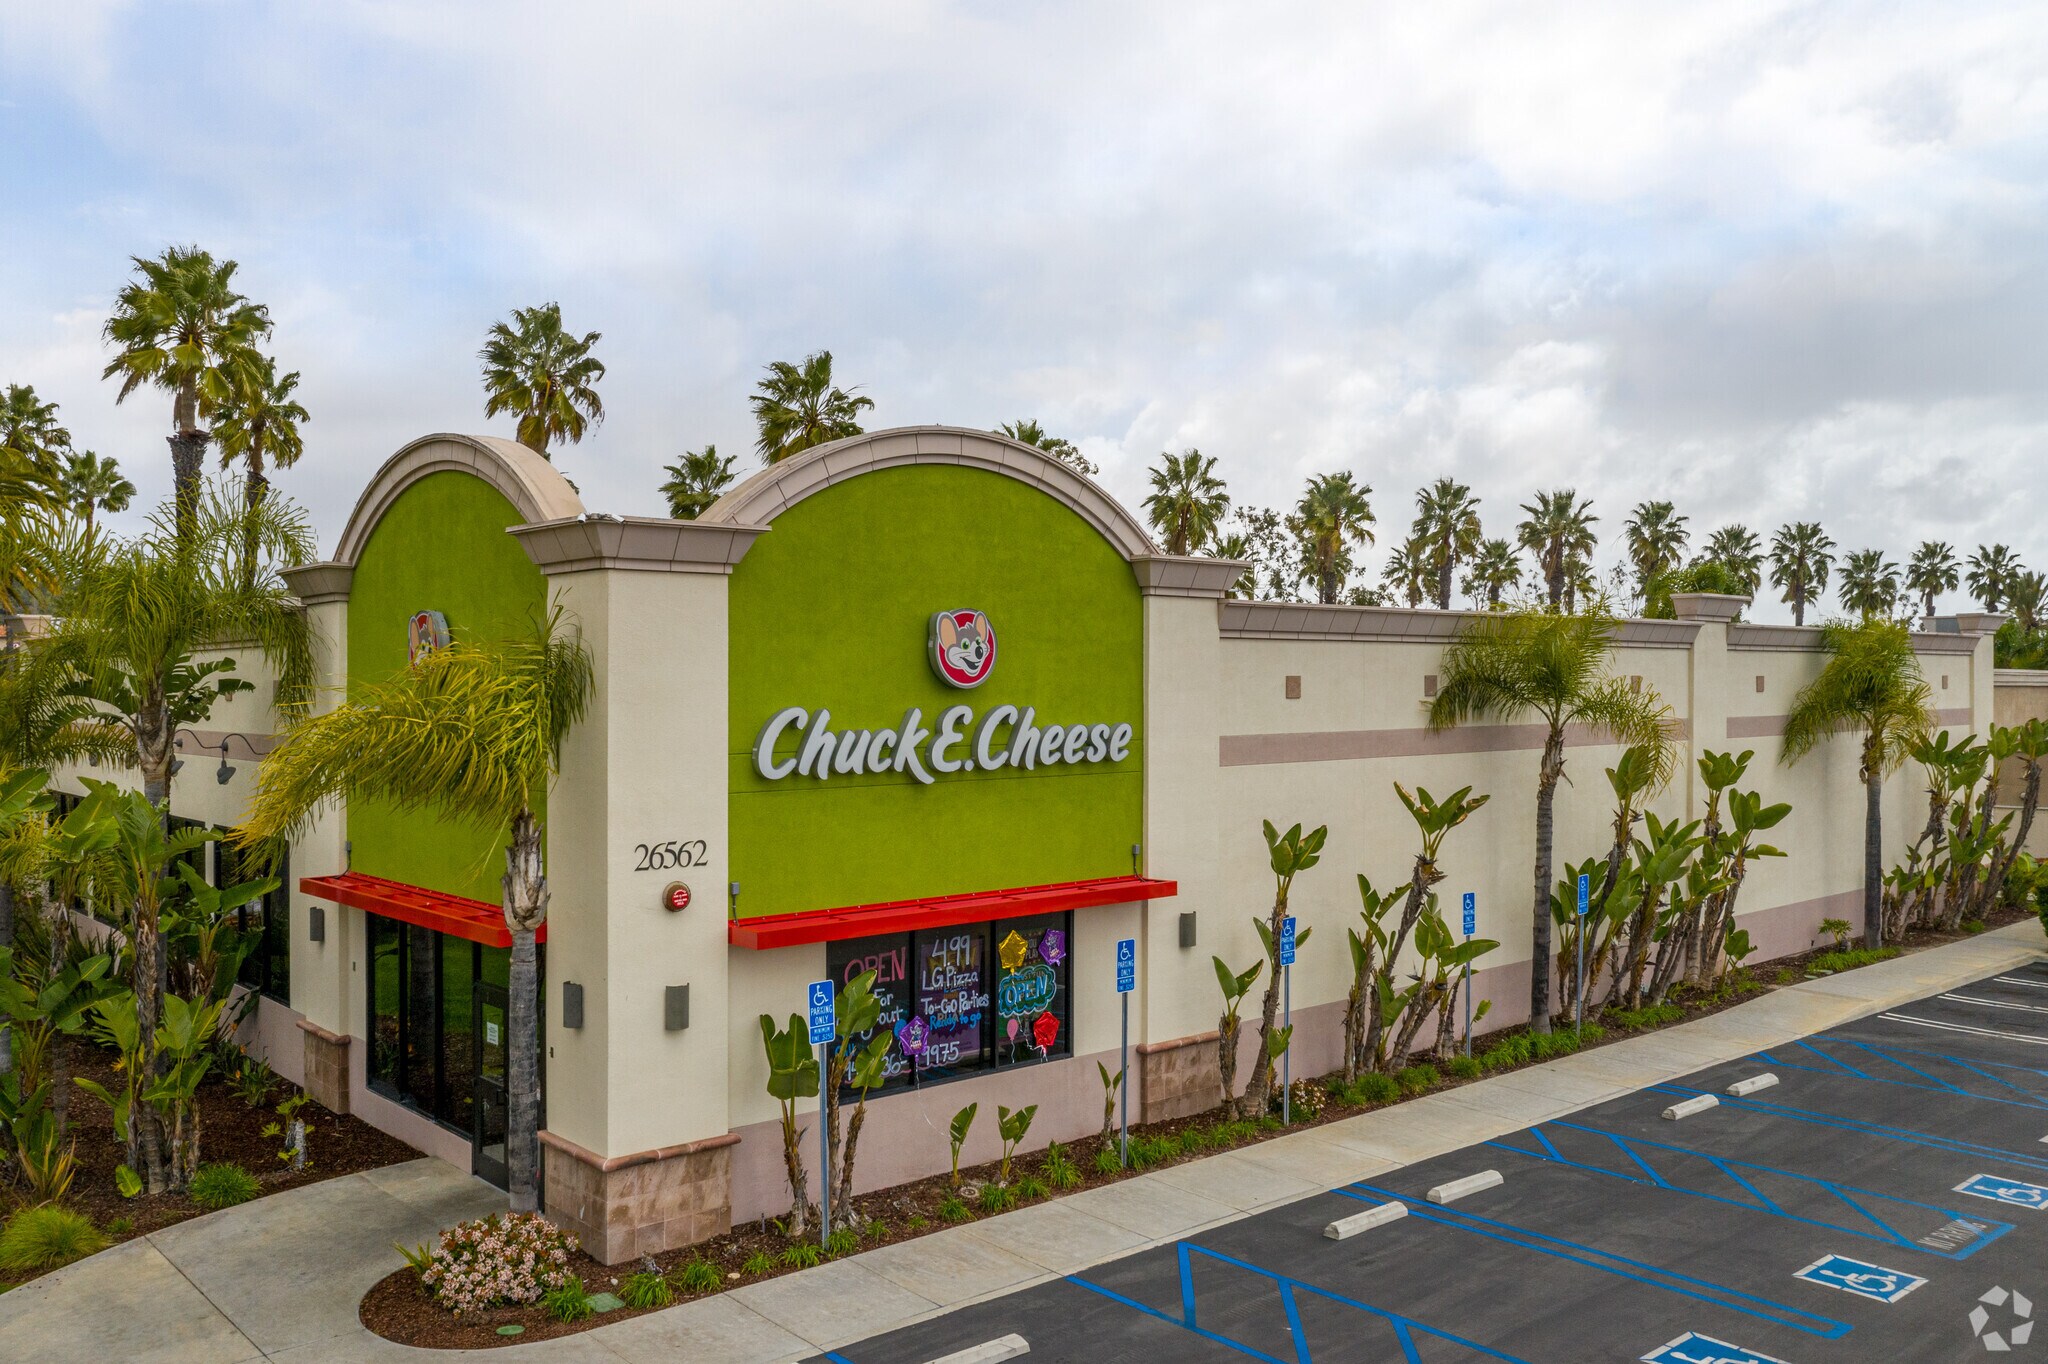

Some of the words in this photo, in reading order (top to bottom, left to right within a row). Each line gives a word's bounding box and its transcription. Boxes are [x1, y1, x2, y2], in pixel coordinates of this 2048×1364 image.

[753, 706, 935, 785] Chuck
[926, 704, 975, 773] E.
[973, 704, 1133, 772] Cheese
[634, 839, 709, 872] 26562
[931, 934, 971, 967] 4.99
[843, 946, 907, 985] OPEN
[946, 966, 979, 988] Pizza
[958, 989, 990, 1013] Parties
[1005, 975, 1048, 1007] OPEN
[810, 1004, 833, 1016] PARKING
[814, 1015, 829, 1025] ONLY
[929, 1012, 957, 1032] Ready
[959, 1012, 969, 1025] to
[969, 1012, 982, 1029] go
